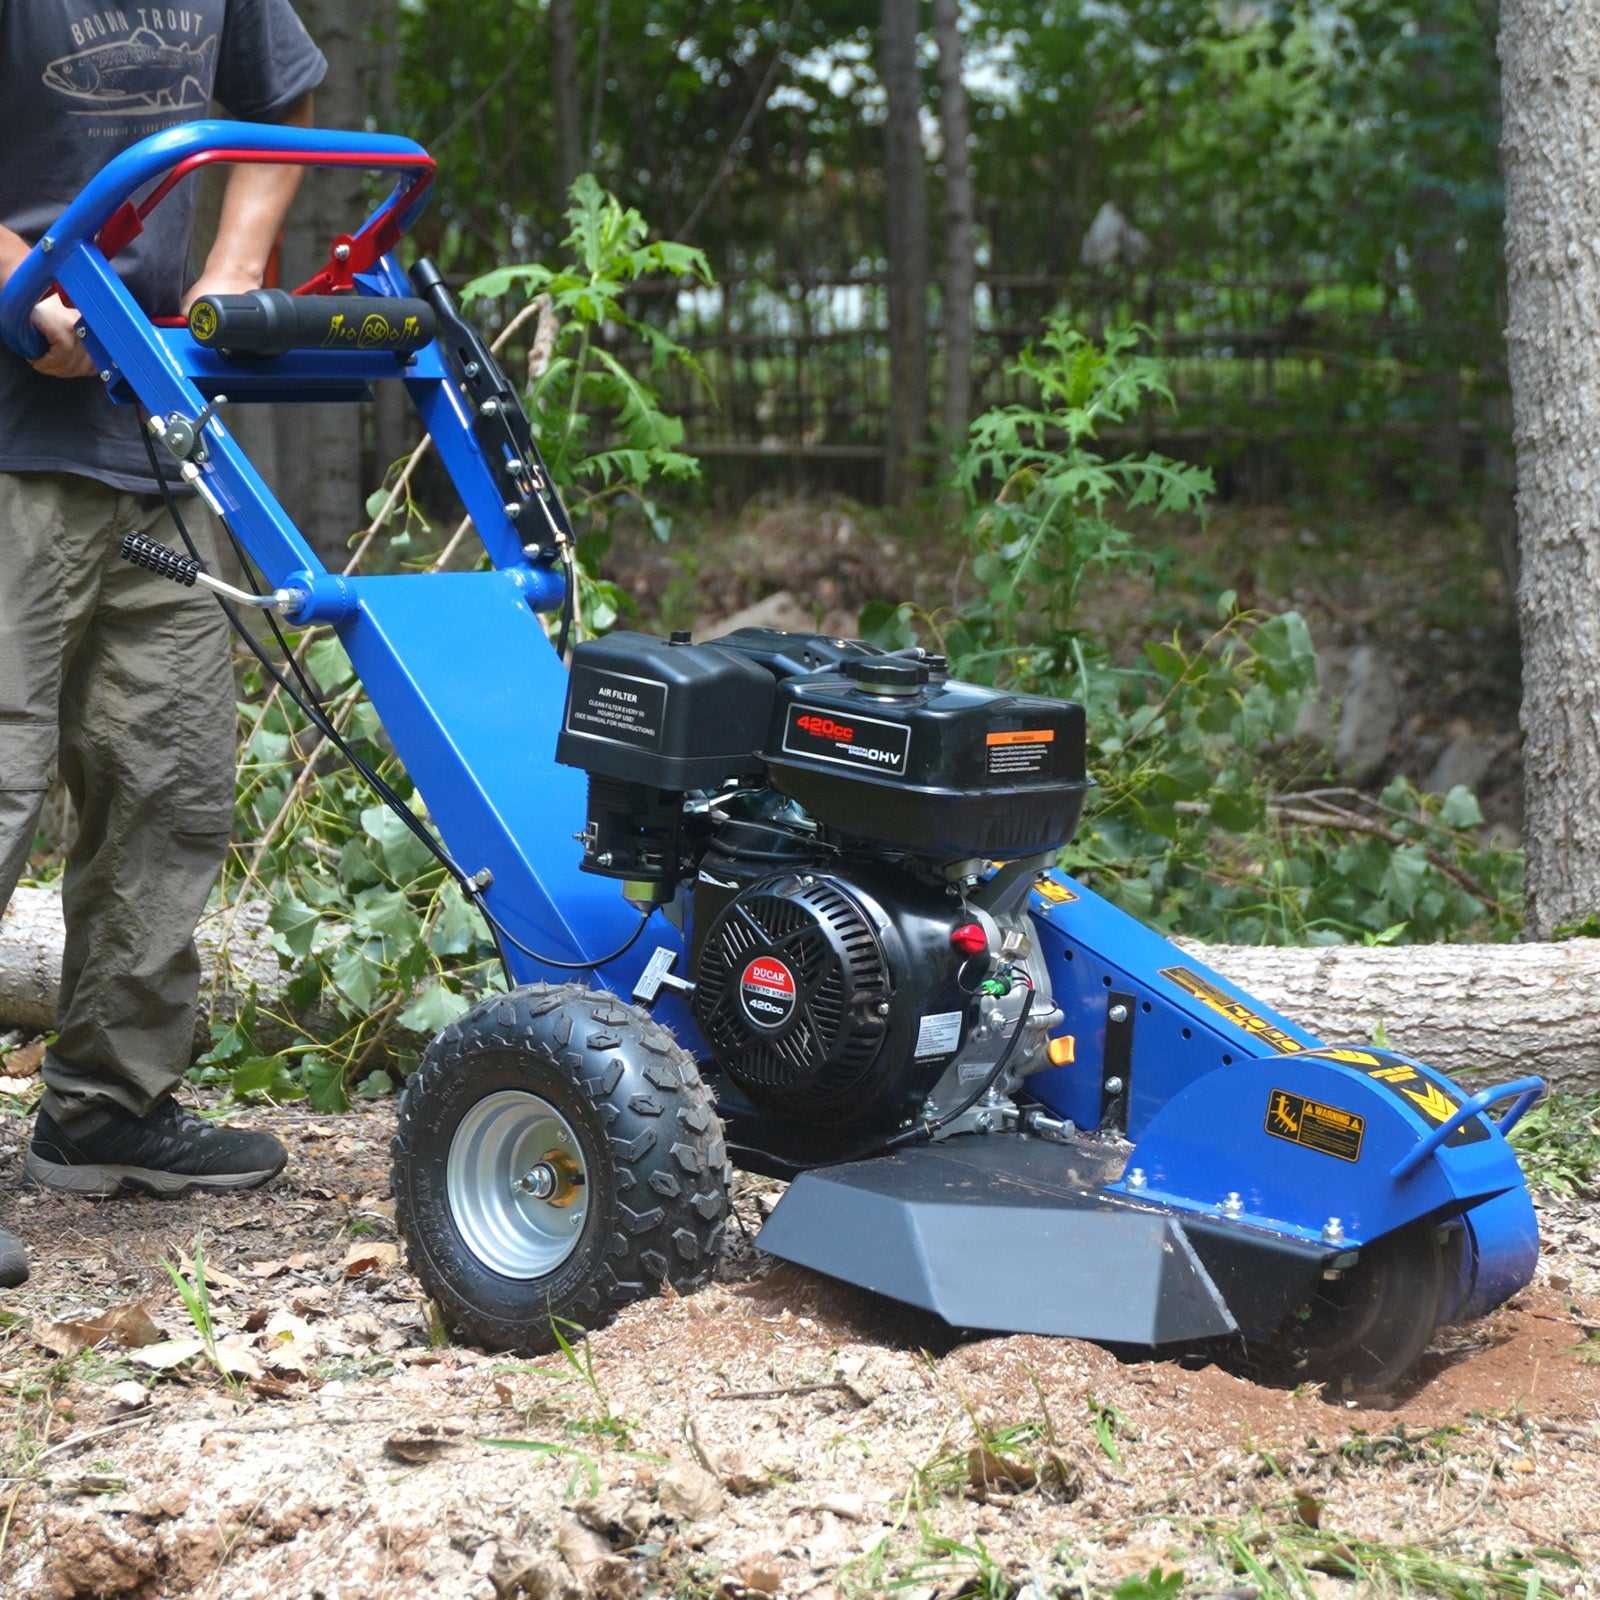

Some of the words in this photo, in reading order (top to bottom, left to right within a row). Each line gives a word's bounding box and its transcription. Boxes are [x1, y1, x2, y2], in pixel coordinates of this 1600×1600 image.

[71, 10, 129, 46] BROWN
[137, 8, 203, 36] TROUT
[598, 687, 612, 697] AIR
[612, 690, 638, 703] FILTER
[588, 699, 605, 708] CLEAN
[605, 703, 622, 712] FILTER
[622, 707, 638, 715] EVERY
[597, 709, 614, 718] HOURS
[586, 714, 607, 725] MANUAL
[607, 719, 617, 727] FOR
[796, 715, 854, 738] 420cc
[867, 748, 901, 764] OHV
[752, 967, 785, 982] DUCAR
[762, 987, 771, 995] TO
[772, 990, 793, 999] START
[749, 999, 784, 1015] 420cc
[1314, 1105, 1351, 1126] WARNING
